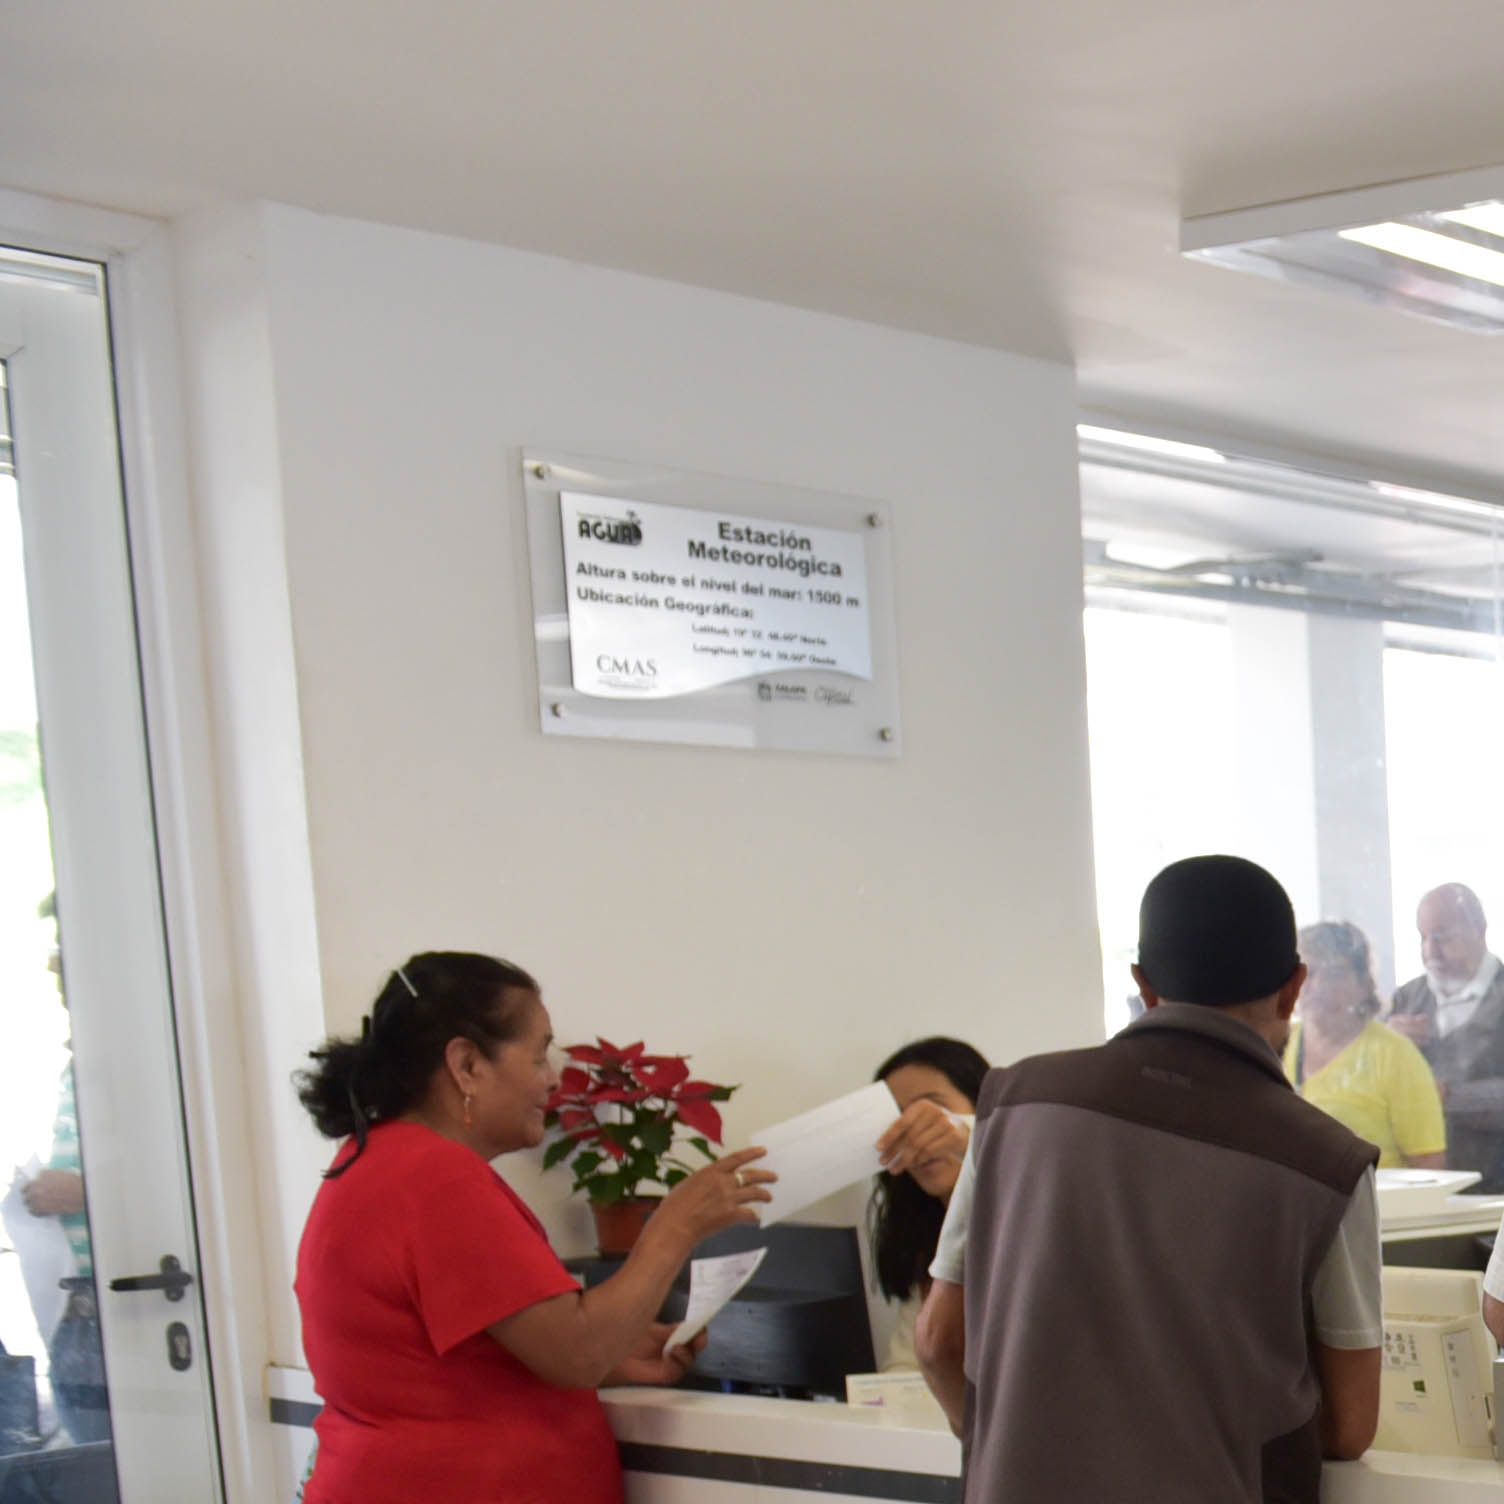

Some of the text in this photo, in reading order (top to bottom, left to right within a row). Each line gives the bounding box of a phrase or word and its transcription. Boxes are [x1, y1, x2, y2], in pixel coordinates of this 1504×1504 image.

[718, 521, 812, 551] Estación
[688, 540, 842, 578] Meteorológica
[576, 561, 626, 580] Altura
[632, 570, 677, 585] sobre
[681, 573, 696, 588] el
[701, 577, 736, 593] nivel
[741, 581, 764, 595] del
[808, 589, 842, 606] 1500
[846, 596, 860, 607] m
[576, 586, 659, 608] Ubicación
[596, 655, 658, 677] CMAS
